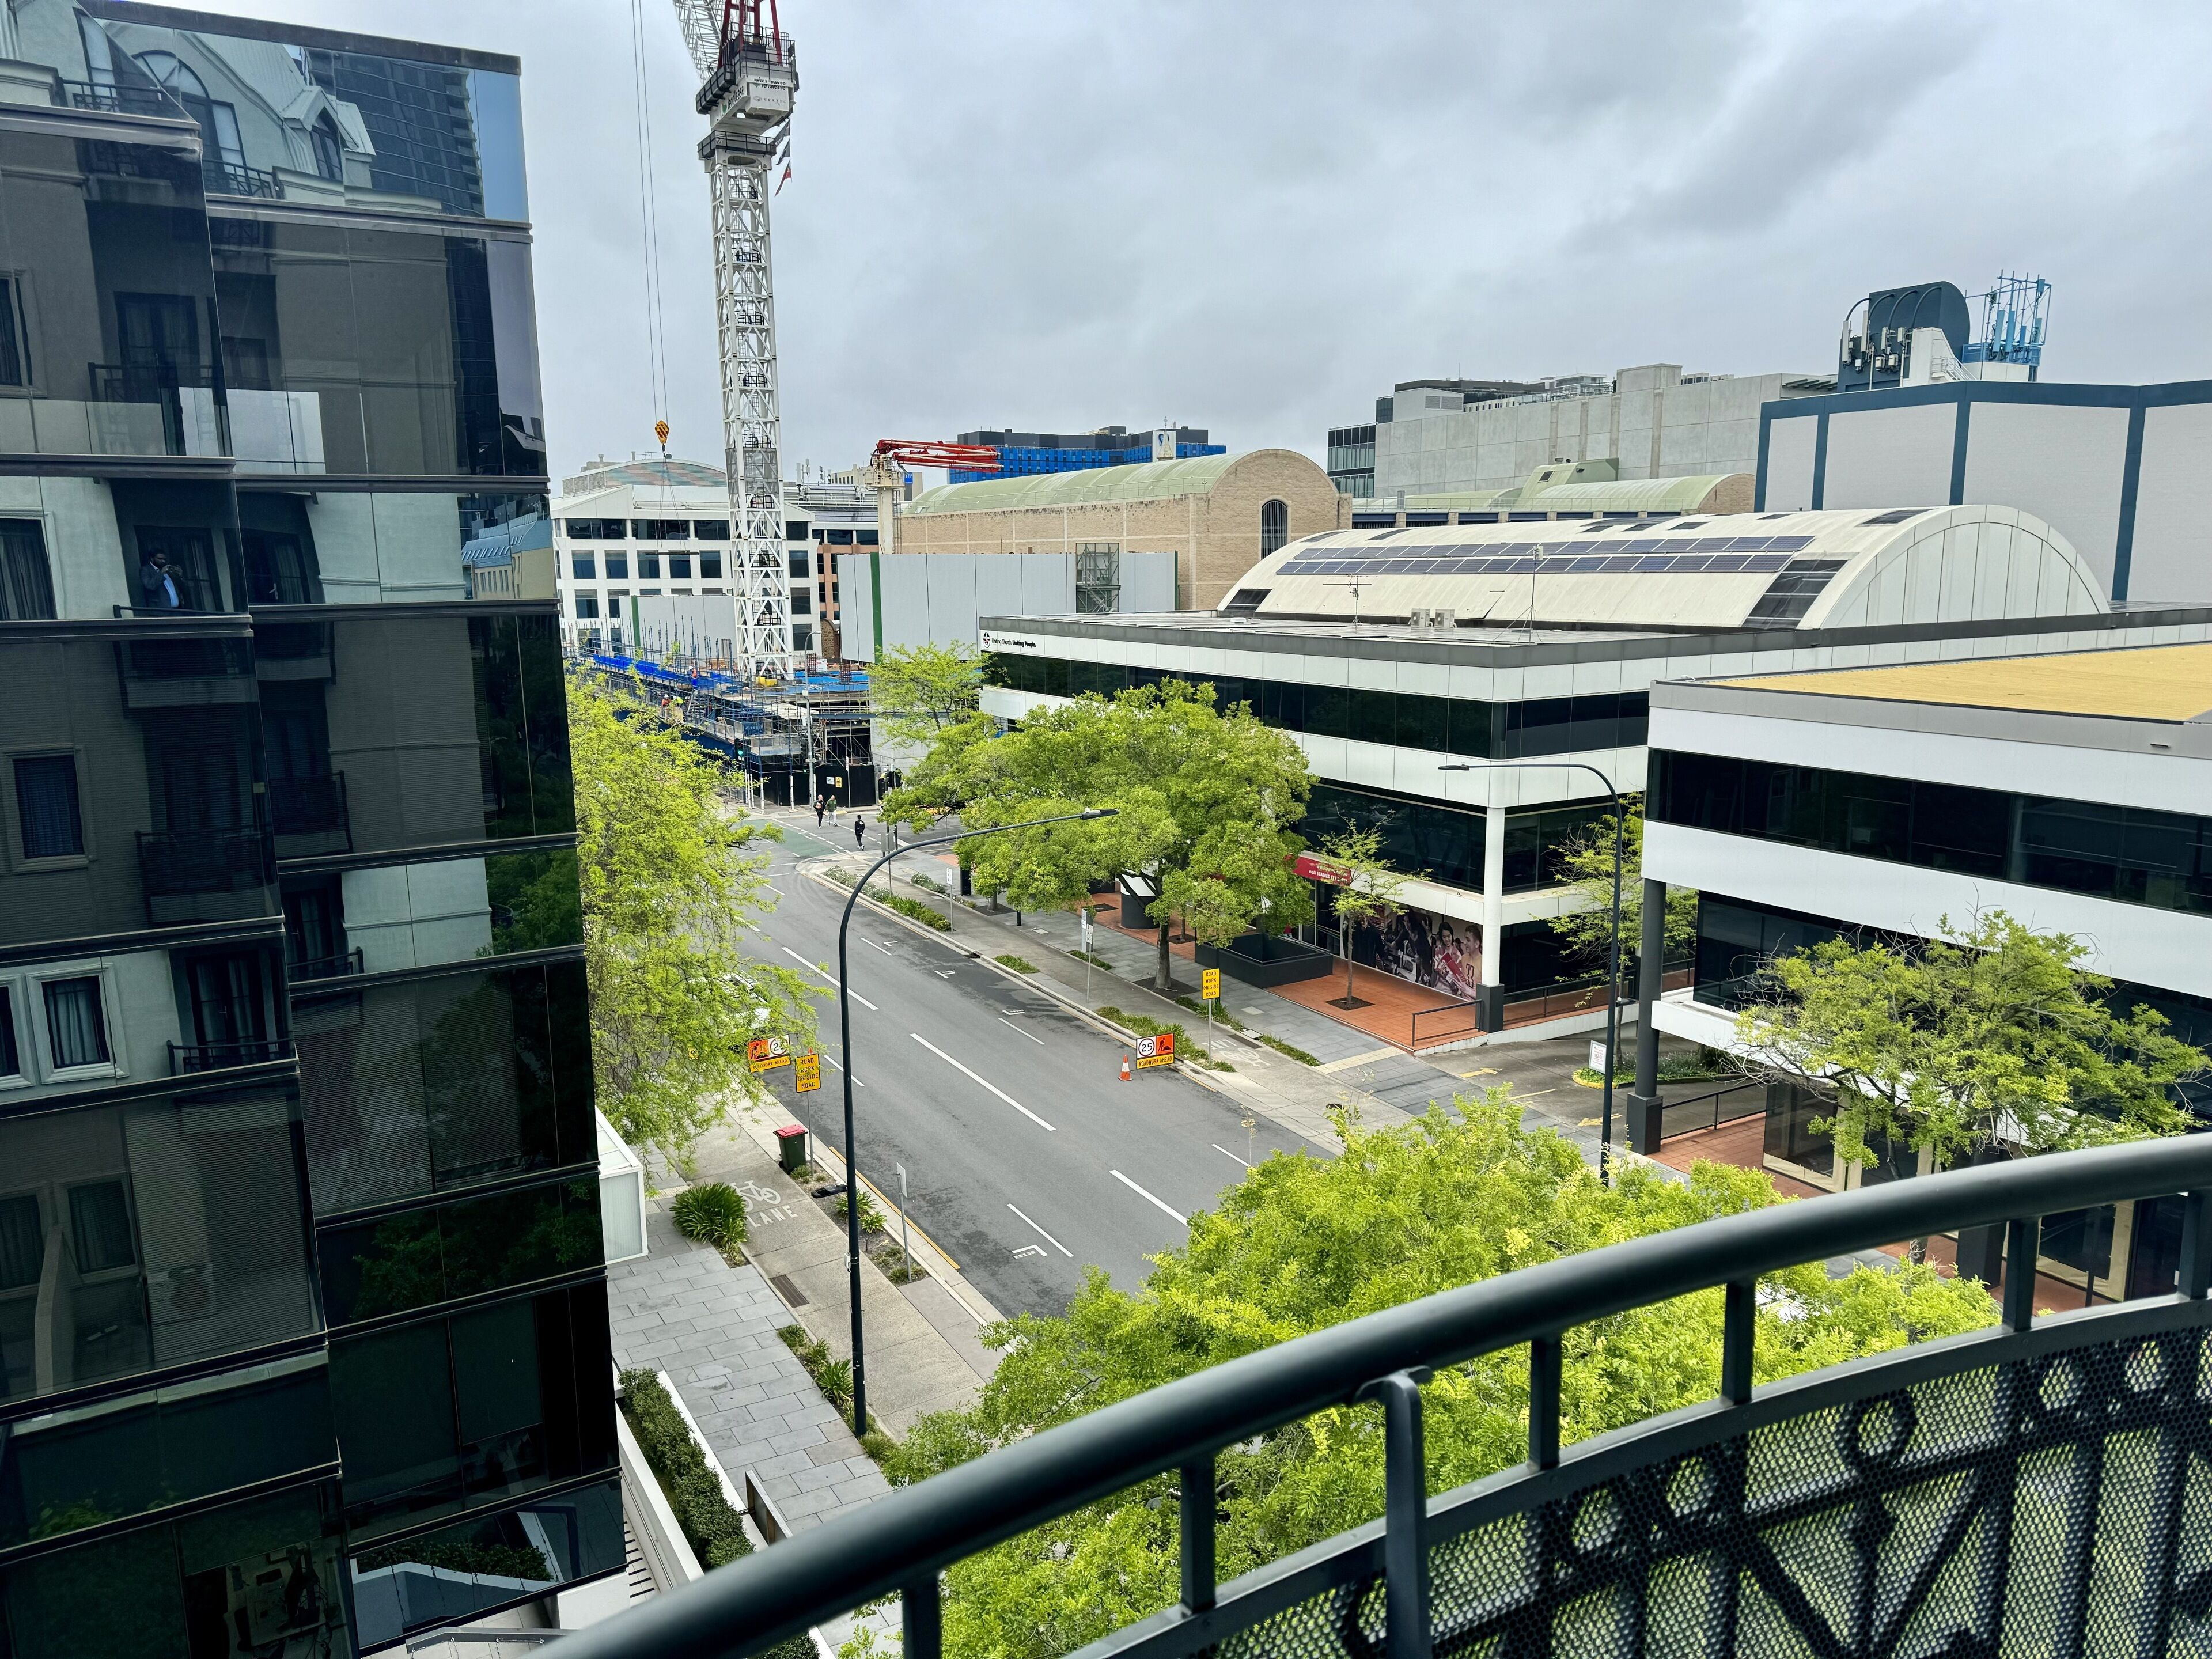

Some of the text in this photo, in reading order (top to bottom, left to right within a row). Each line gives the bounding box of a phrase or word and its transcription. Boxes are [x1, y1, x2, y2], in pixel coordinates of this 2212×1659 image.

[1141, 1043, 1152, 1052] 25
[1139, 1059, 1158, 1067] ROADWORK
[747, 1206, 798, 1227] LANE
